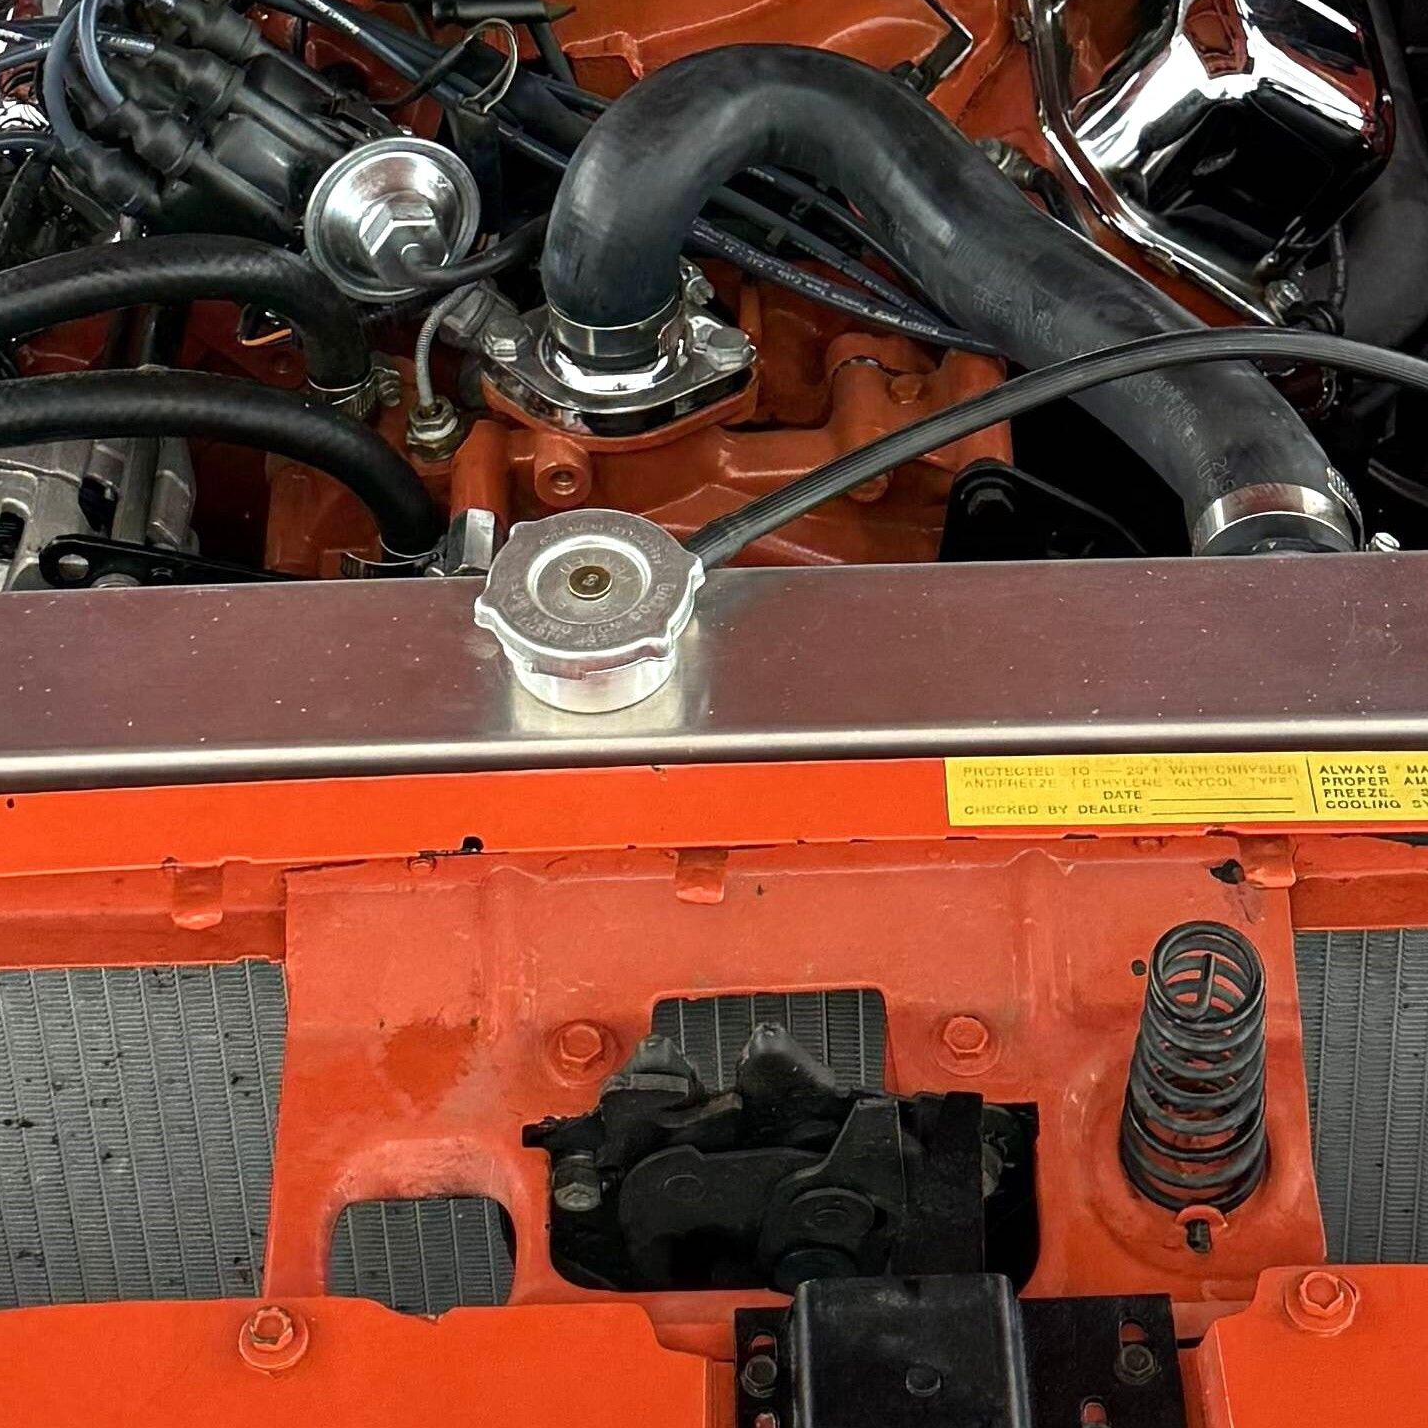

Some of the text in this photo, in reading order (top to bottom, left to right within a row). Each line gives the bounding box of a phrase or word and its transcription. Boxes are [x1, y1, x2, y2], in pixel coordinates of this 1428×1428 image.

[963, 765, 1055, 777] PROTECTED
[1071, 765, 1090, 777] TO
[1215, 763, 1298, 776] CHRYSLER
[1319, 763, 1388, 776] ALWAYS
[964, 777, 1058, 789] ANTIFREEZE
[1321, 775, 1391, 787] PROPER
[1103, 789, 1142, 801] DATE
[963, 804, 1040, 816] CHECKED
[1047, 804, 1069, 816] BY
[1324, 798, 1402, 810] COOLING
